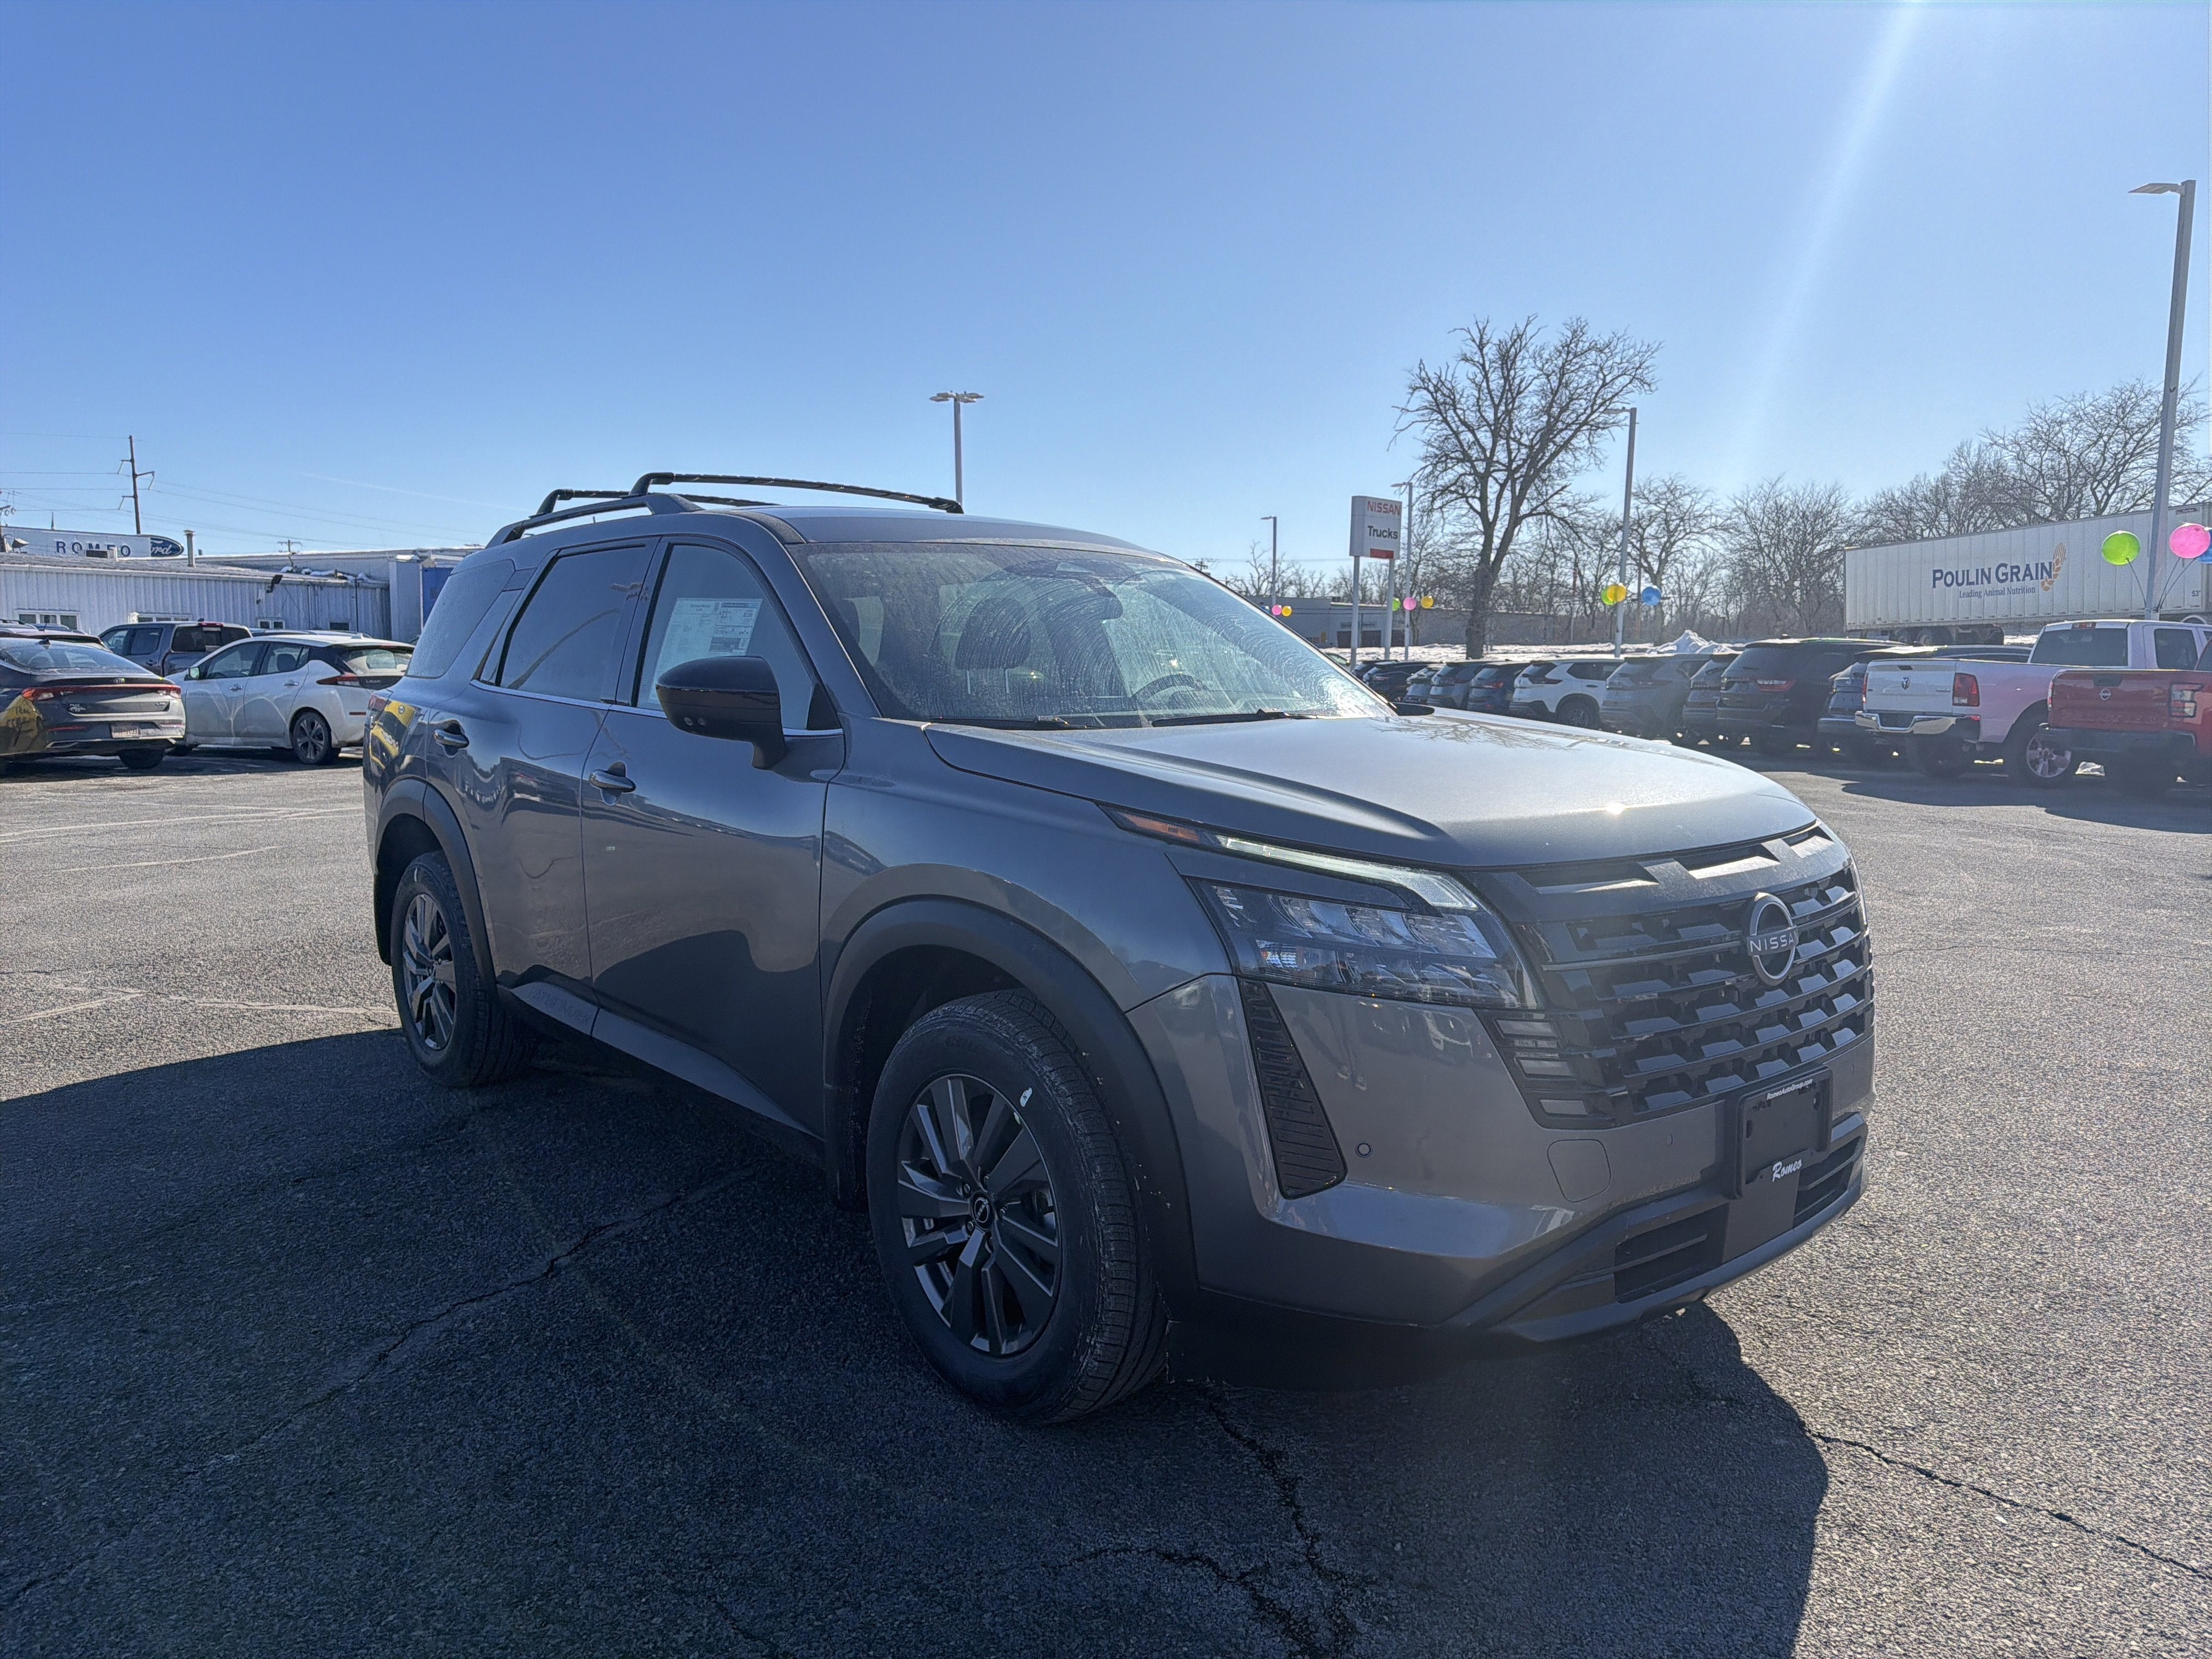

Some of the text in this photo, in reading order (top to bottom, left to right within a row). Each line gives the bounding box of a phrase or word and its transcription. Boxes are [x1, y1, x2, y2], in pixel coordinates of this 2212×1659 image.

[1367, 500, 1401, 515] NISSAN
[1368, 525, 1398, 539] Trucks
[1932, 561, 2053, 589] POULIN GRAIN
[1959, 585, 2036, 599] Leading Animal Nutrition
[1772, 1159, 1802, 1183] Romeo
